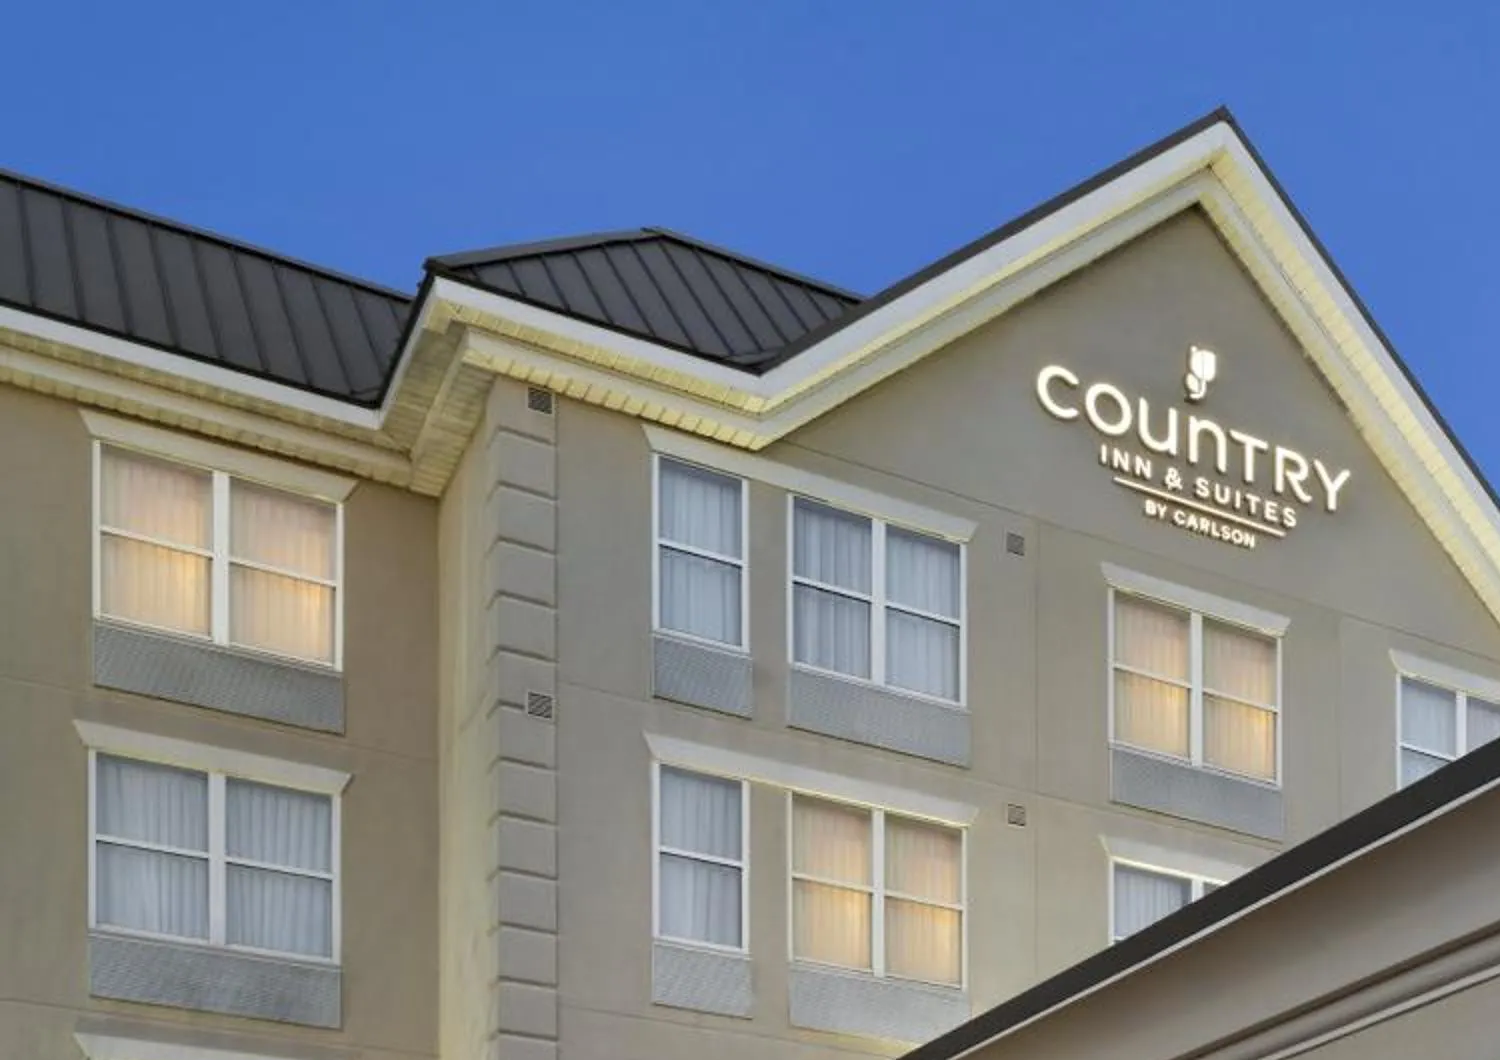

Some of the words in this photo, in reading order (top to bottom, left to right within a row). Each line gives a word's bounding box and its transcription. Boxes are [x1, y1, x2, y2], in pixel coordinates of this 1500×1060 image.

[1101, 444, 1151, 480] INN
[1165, 467, 1183, 492] &
[1196, 477, 1297, 528] SUITES
[1145, 500, 1167, 520] BY
[1173, 511, 1256, 548] CARLSON
